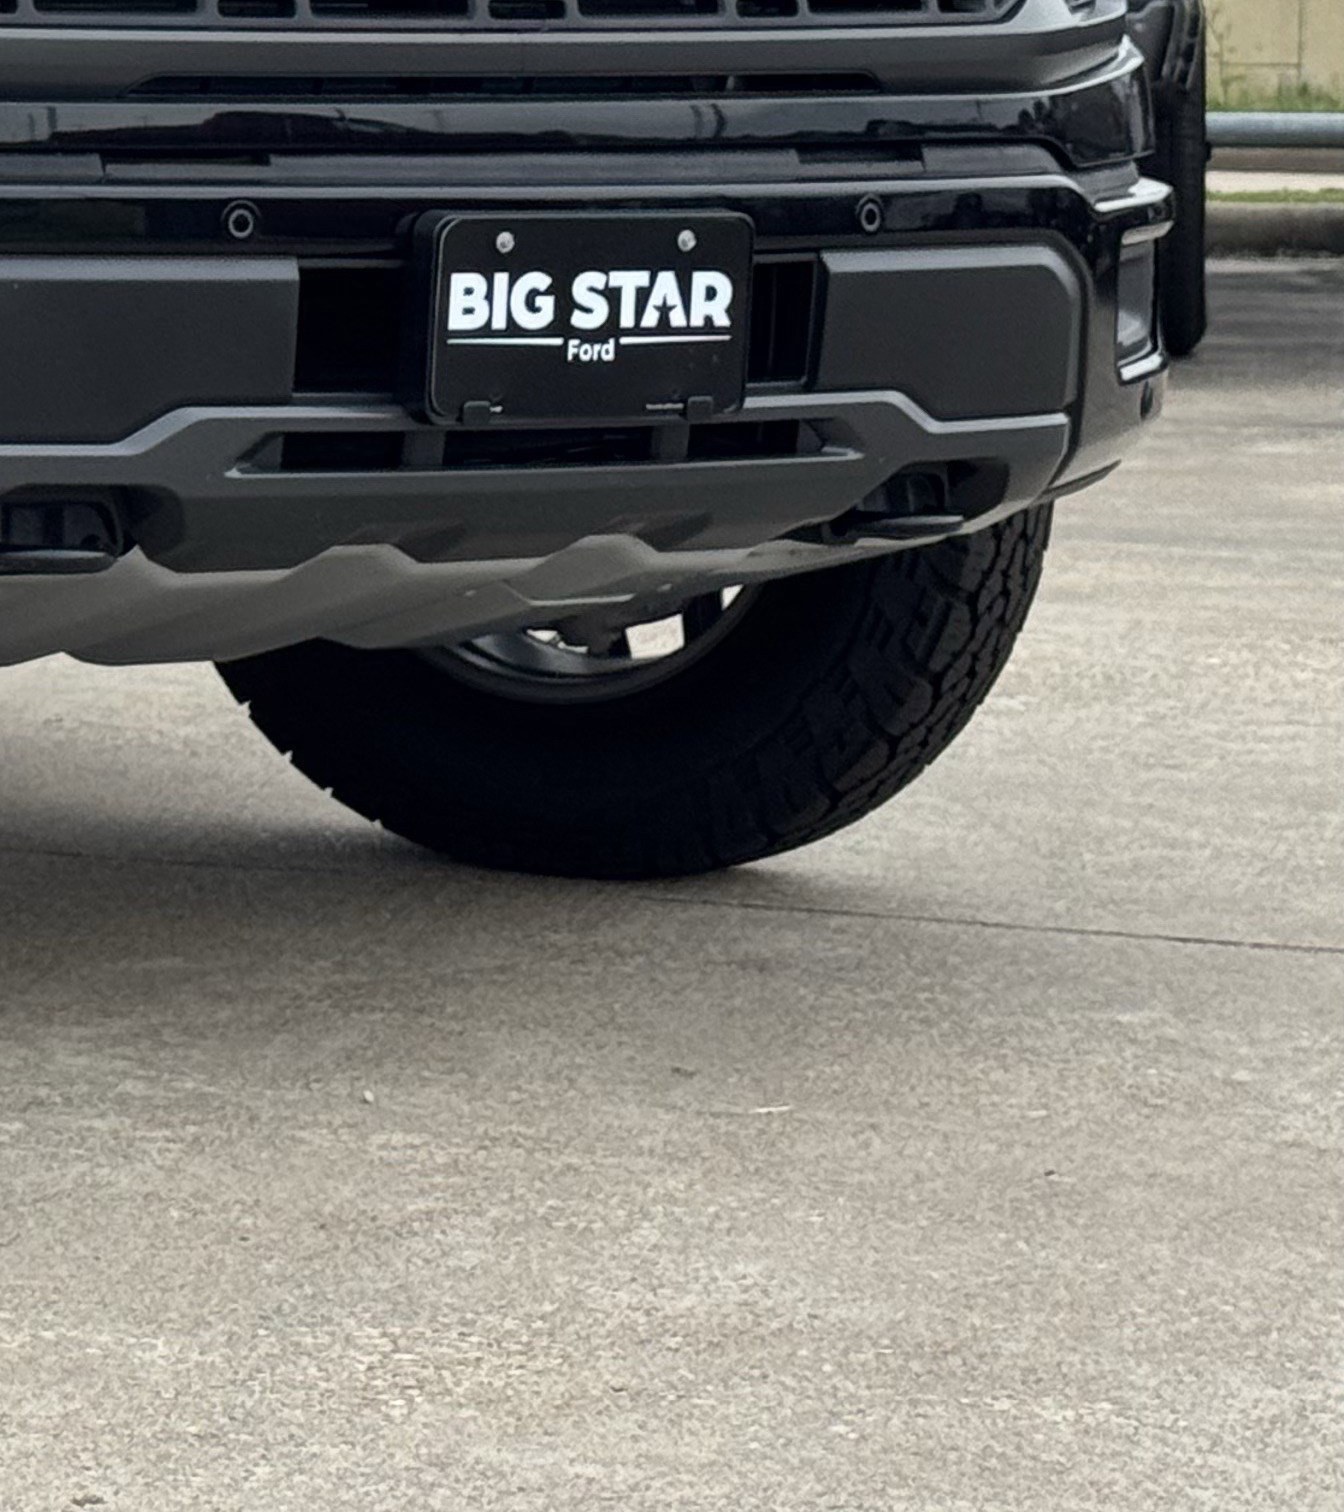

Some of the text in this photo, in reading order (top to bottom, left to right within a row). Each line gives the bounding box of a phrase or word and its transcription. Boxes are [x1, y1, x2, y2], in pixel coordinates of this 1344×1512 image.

[446, 270, 734, 331] BIG STAR
[566, 338, 616, 363] Ford
